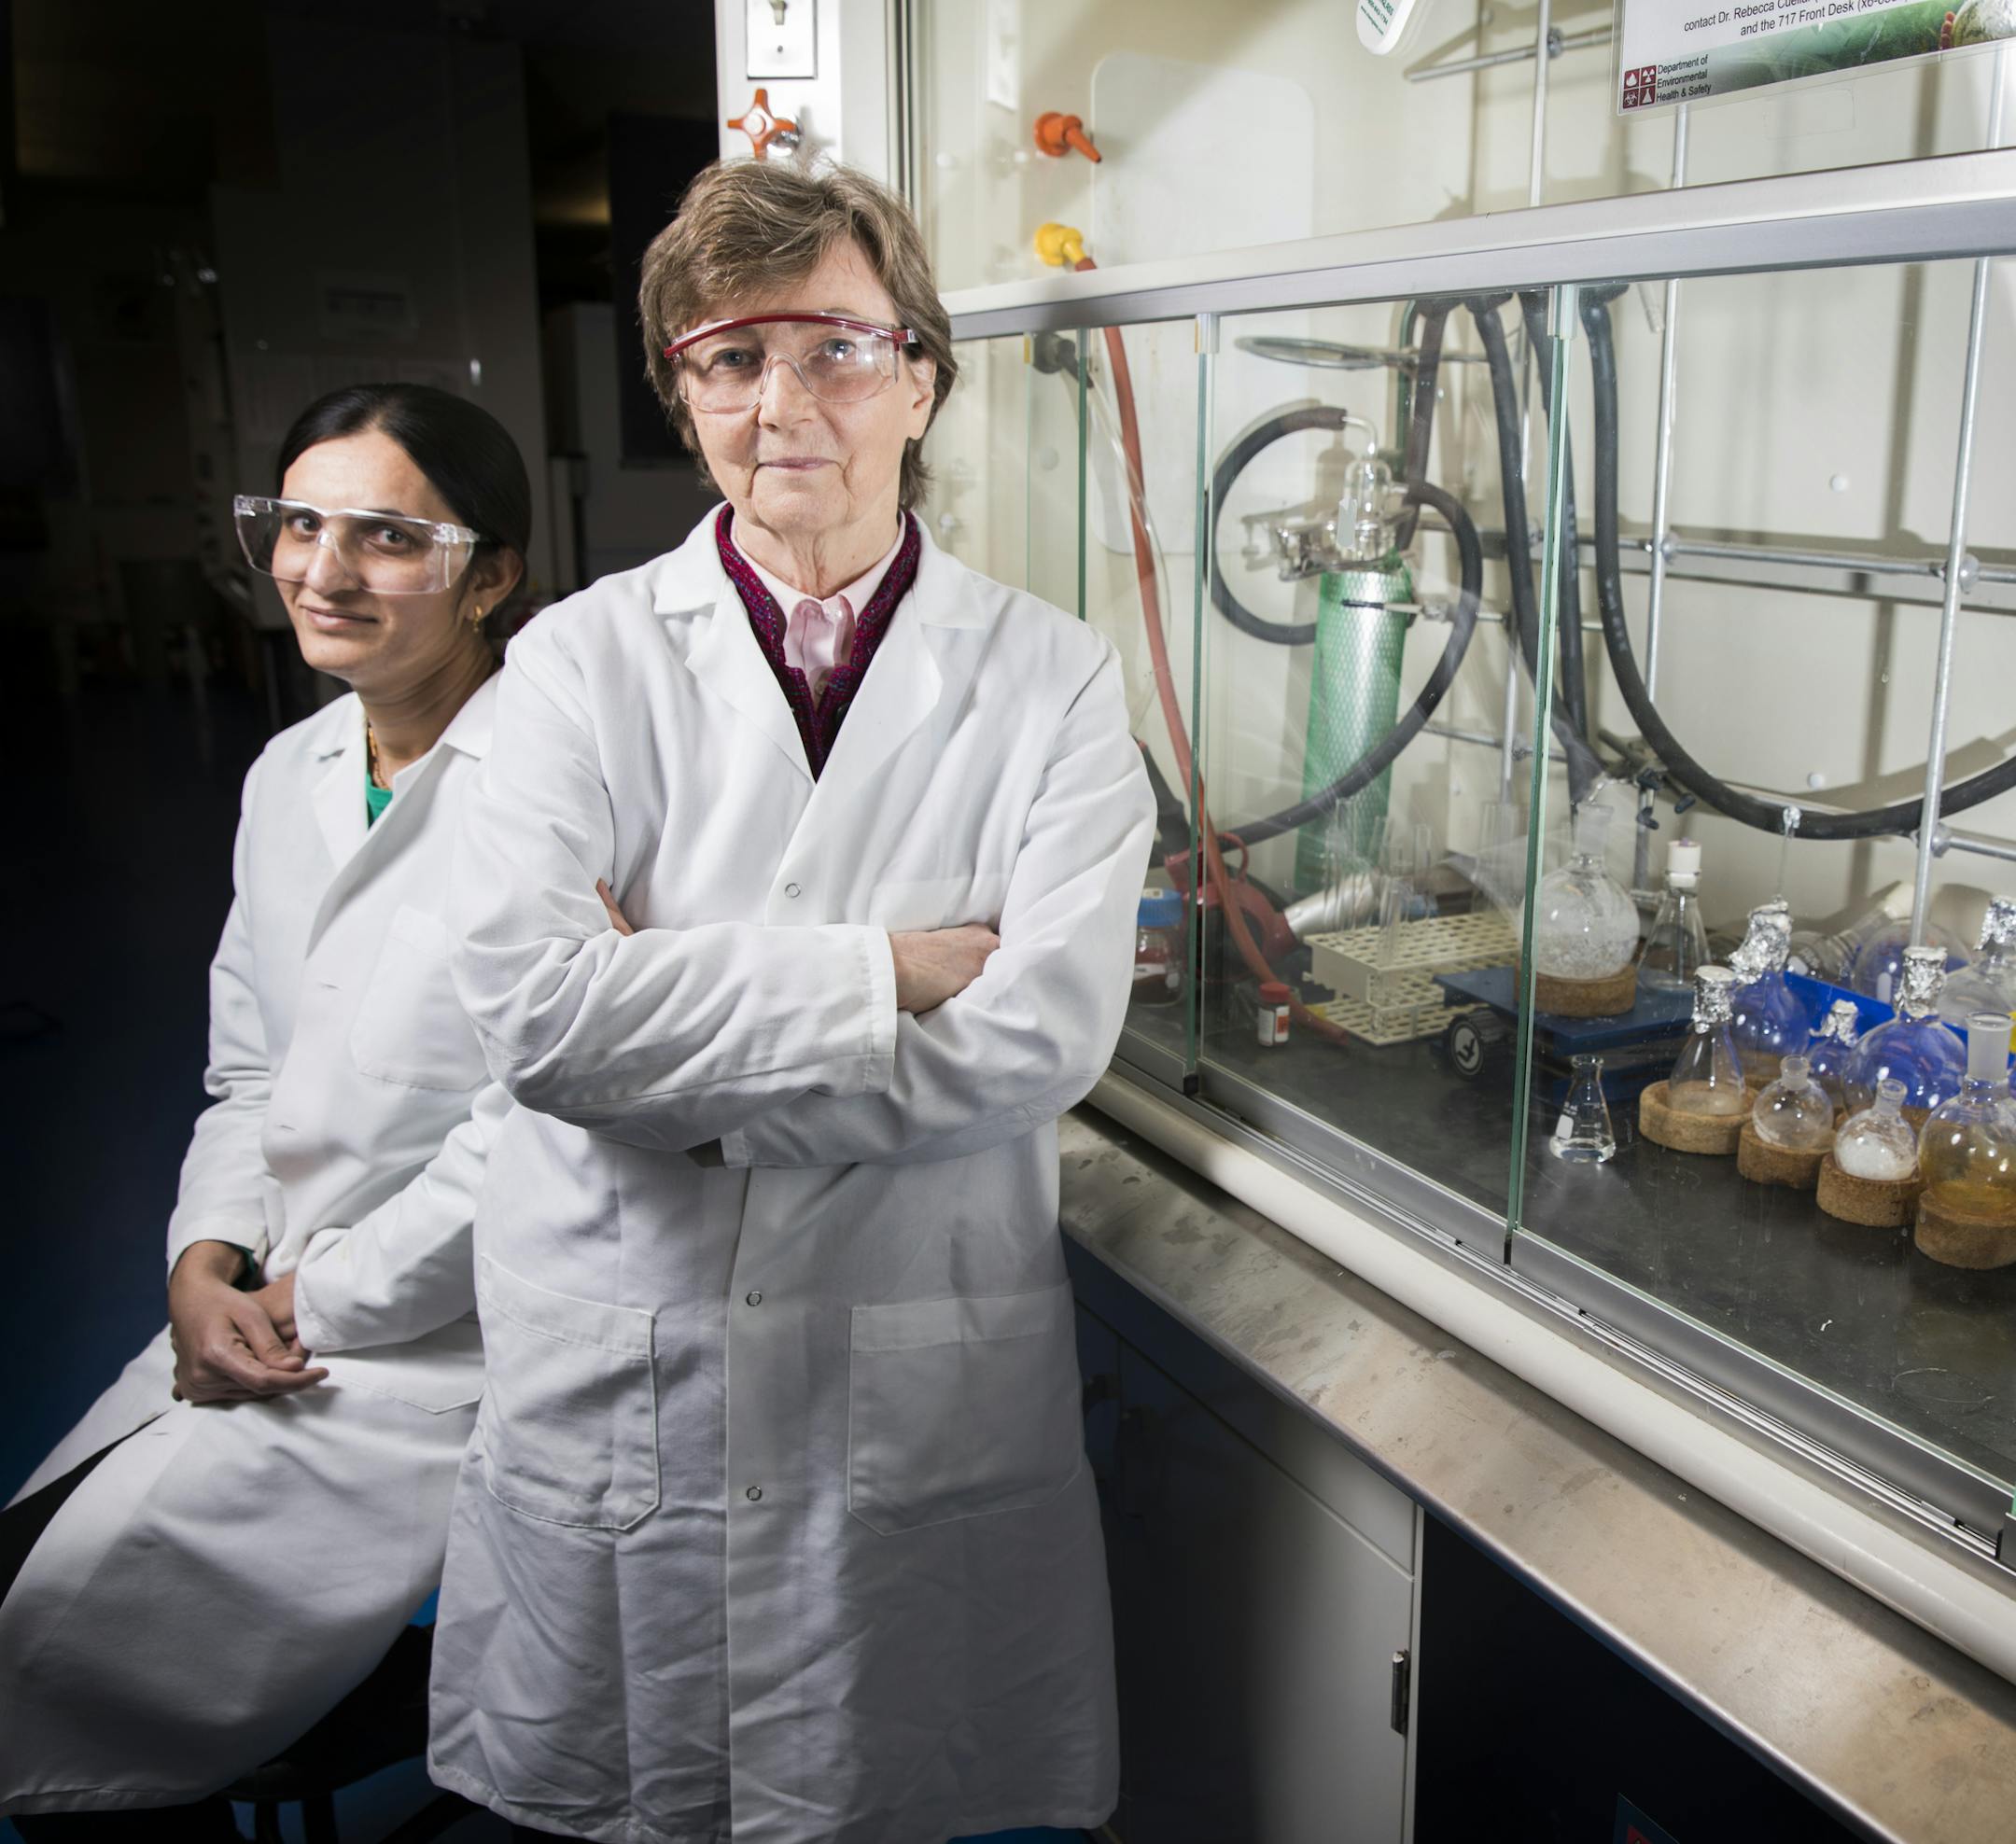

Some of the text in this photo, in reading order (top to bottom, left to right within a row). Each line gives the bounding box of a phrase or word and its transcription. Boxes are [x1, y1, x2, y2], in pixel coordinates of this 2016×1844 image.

[1684, 14, 1715, 32] contact
[1718, 11, 1731, 23] Dr.
[1734, 2, 1774, 20] Rebecca
[1740, 23, 1758, 35] and
[1760, 19, 1775, 32] the
[1779, 12, 1797, 27] 717
[1799, 7, 1825, 22] Front
[1828, 1, 1855, 17] Desk
[1658, 53, 1709, 75] Department of
[1657, 69, 1708, 89] Environmental
[1656, 83, 1712, 103] Health & Safety
